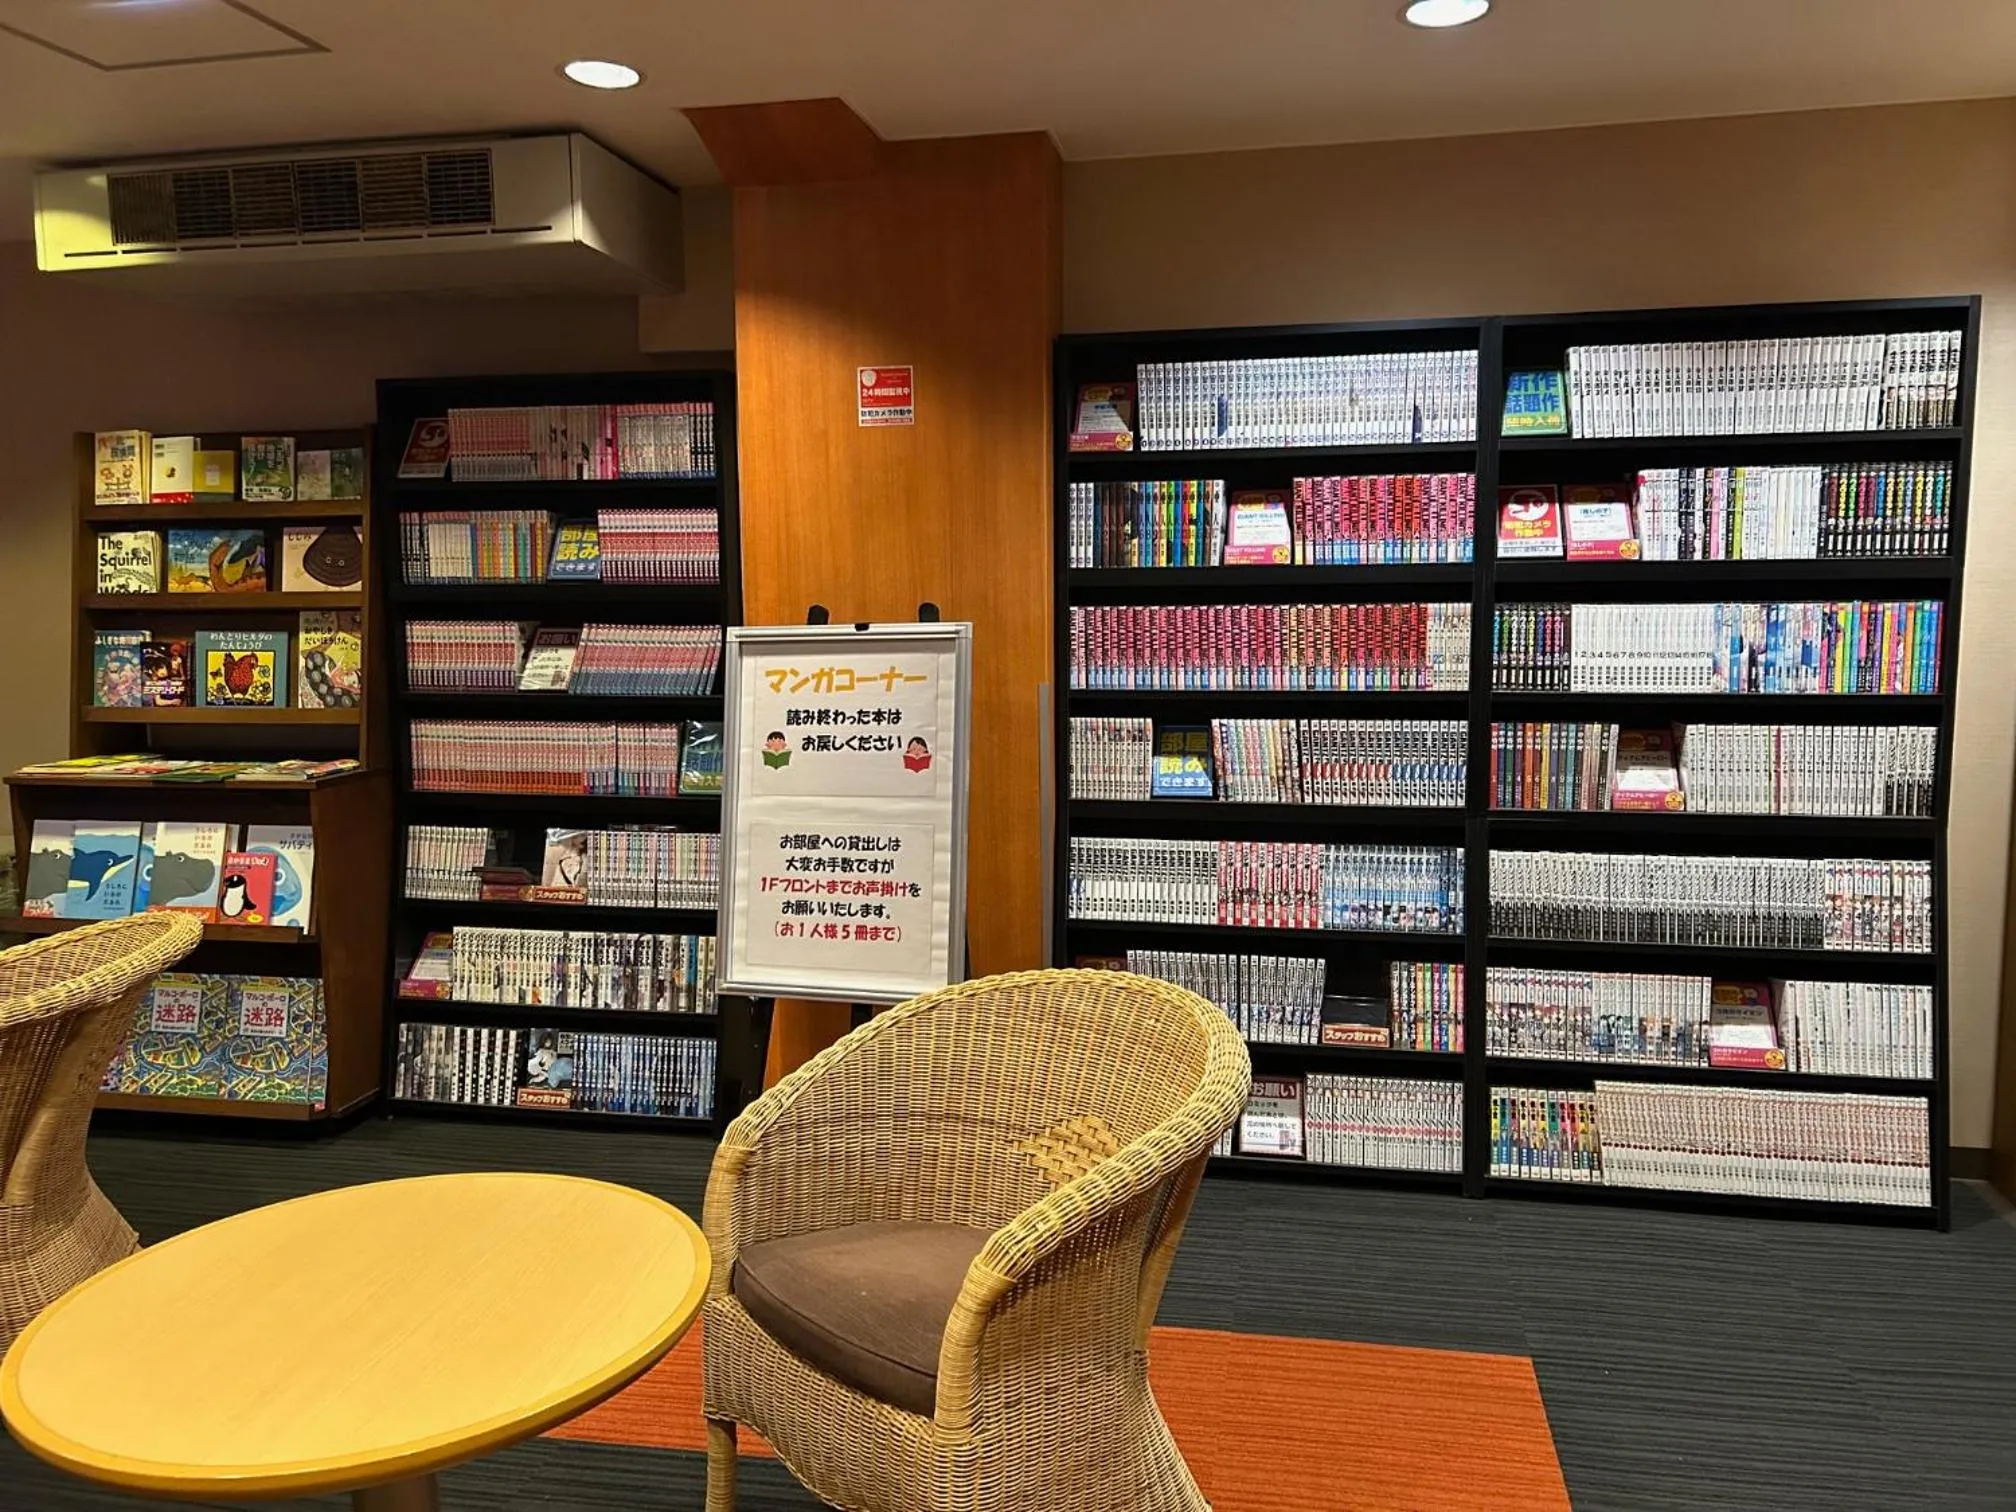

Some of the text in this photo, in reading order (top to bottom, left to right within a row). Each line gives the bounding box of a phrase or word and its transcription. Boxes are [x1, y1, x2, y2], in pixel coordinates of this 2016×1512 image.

[100, 536, 123, 549] The
[100, 552, 152, 570] Squirrel
[100, 570, 112, 583] in
[765, 665, 928, 694] マンガコーナー
[786, 709, 902, 727] 読み終わった本は
[802, 734, 902, 752] お戻しください
[780, 835, 901, 852] お部屋への貸出しは
[785, 857, 895, 873] 大変お手数ですが
[760, 877, 922, 896] 1Fフロントまでお声掛けを
[781, 900, 892, 919] お願いいたします。
[155, 1003, 196, 1023] 迷路
[244, 1006, 284, 1027] 迷路
[1252, 1082, 1295, 1097] お願い
